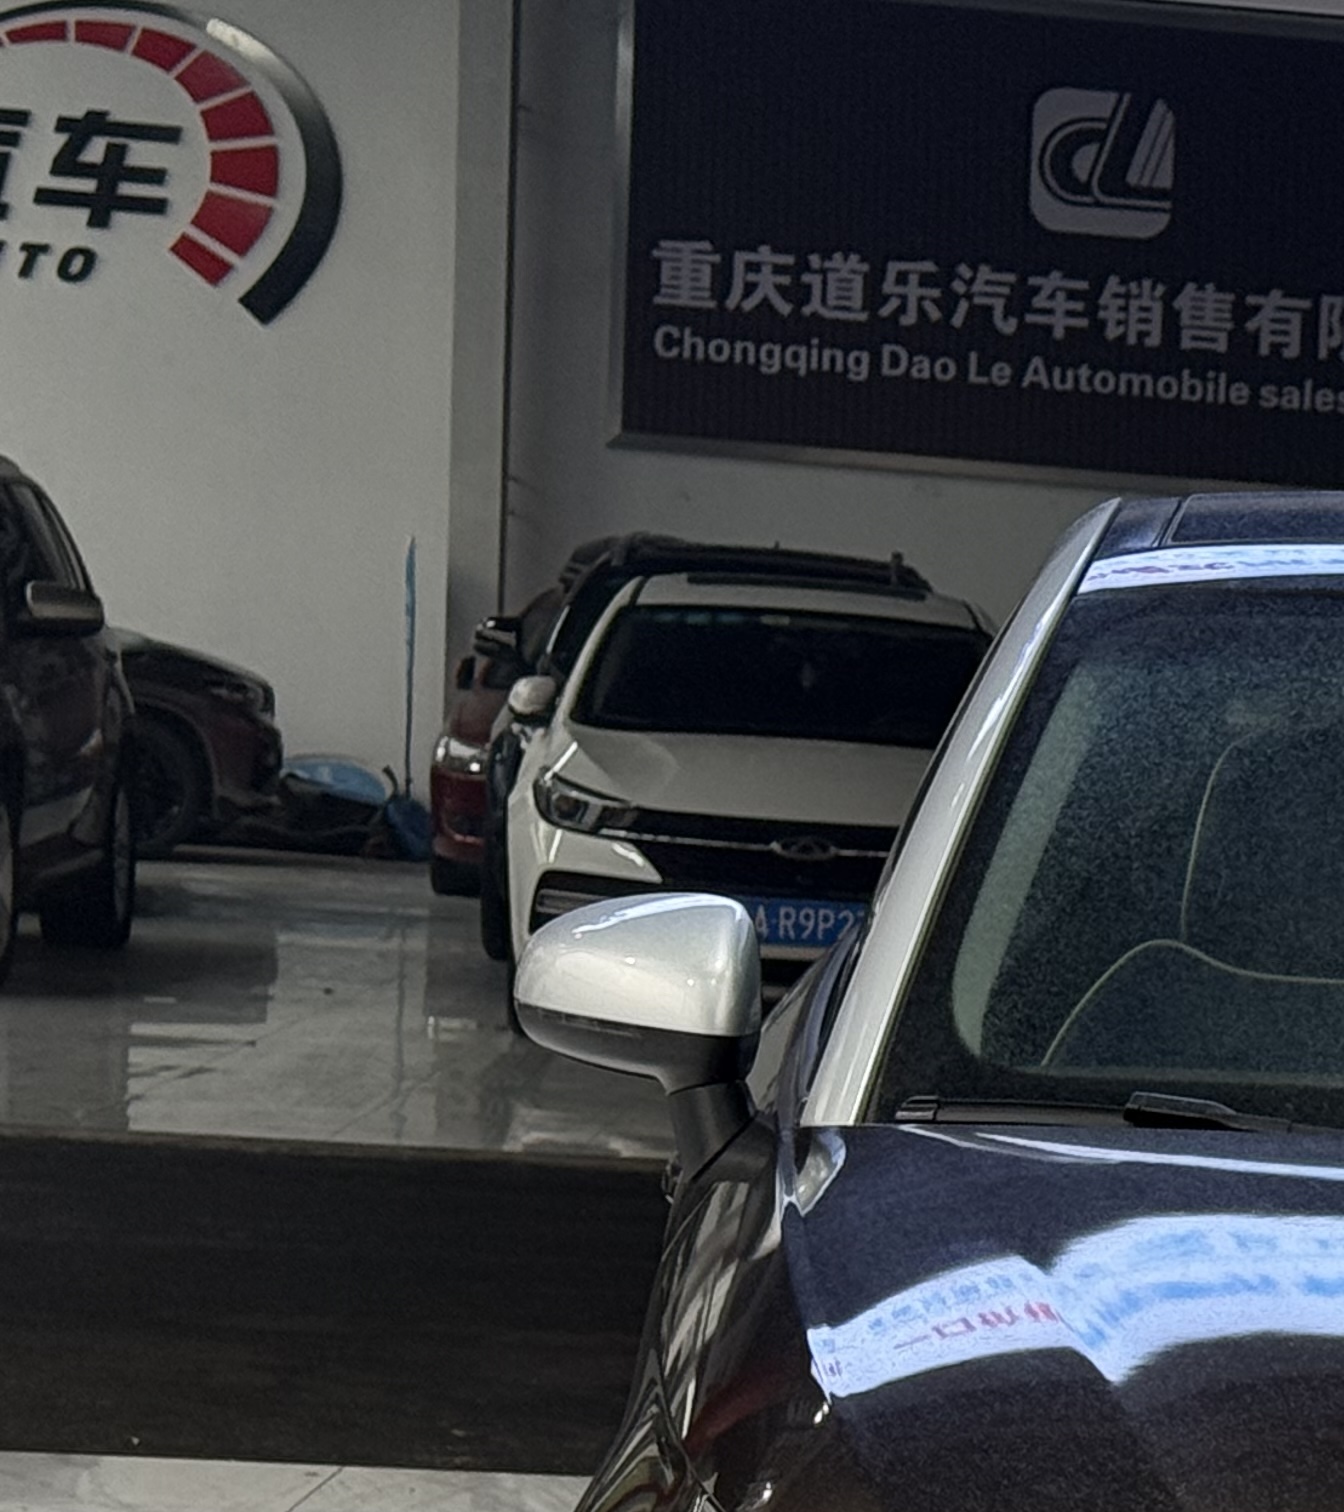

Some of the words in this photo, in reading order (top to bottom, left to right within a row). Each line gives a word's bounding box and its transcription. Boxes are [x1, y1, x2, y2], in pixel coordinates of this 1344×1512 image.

[0, 109, 183, 230] 车
[0, 241, 98, 284] TO
[654, 324, 870, 381] Chongqing
[880, 342, 957, 382] Dao
[966, 350, 1012, 387] Le
[1021, 355, 1250, 407] Automobile
